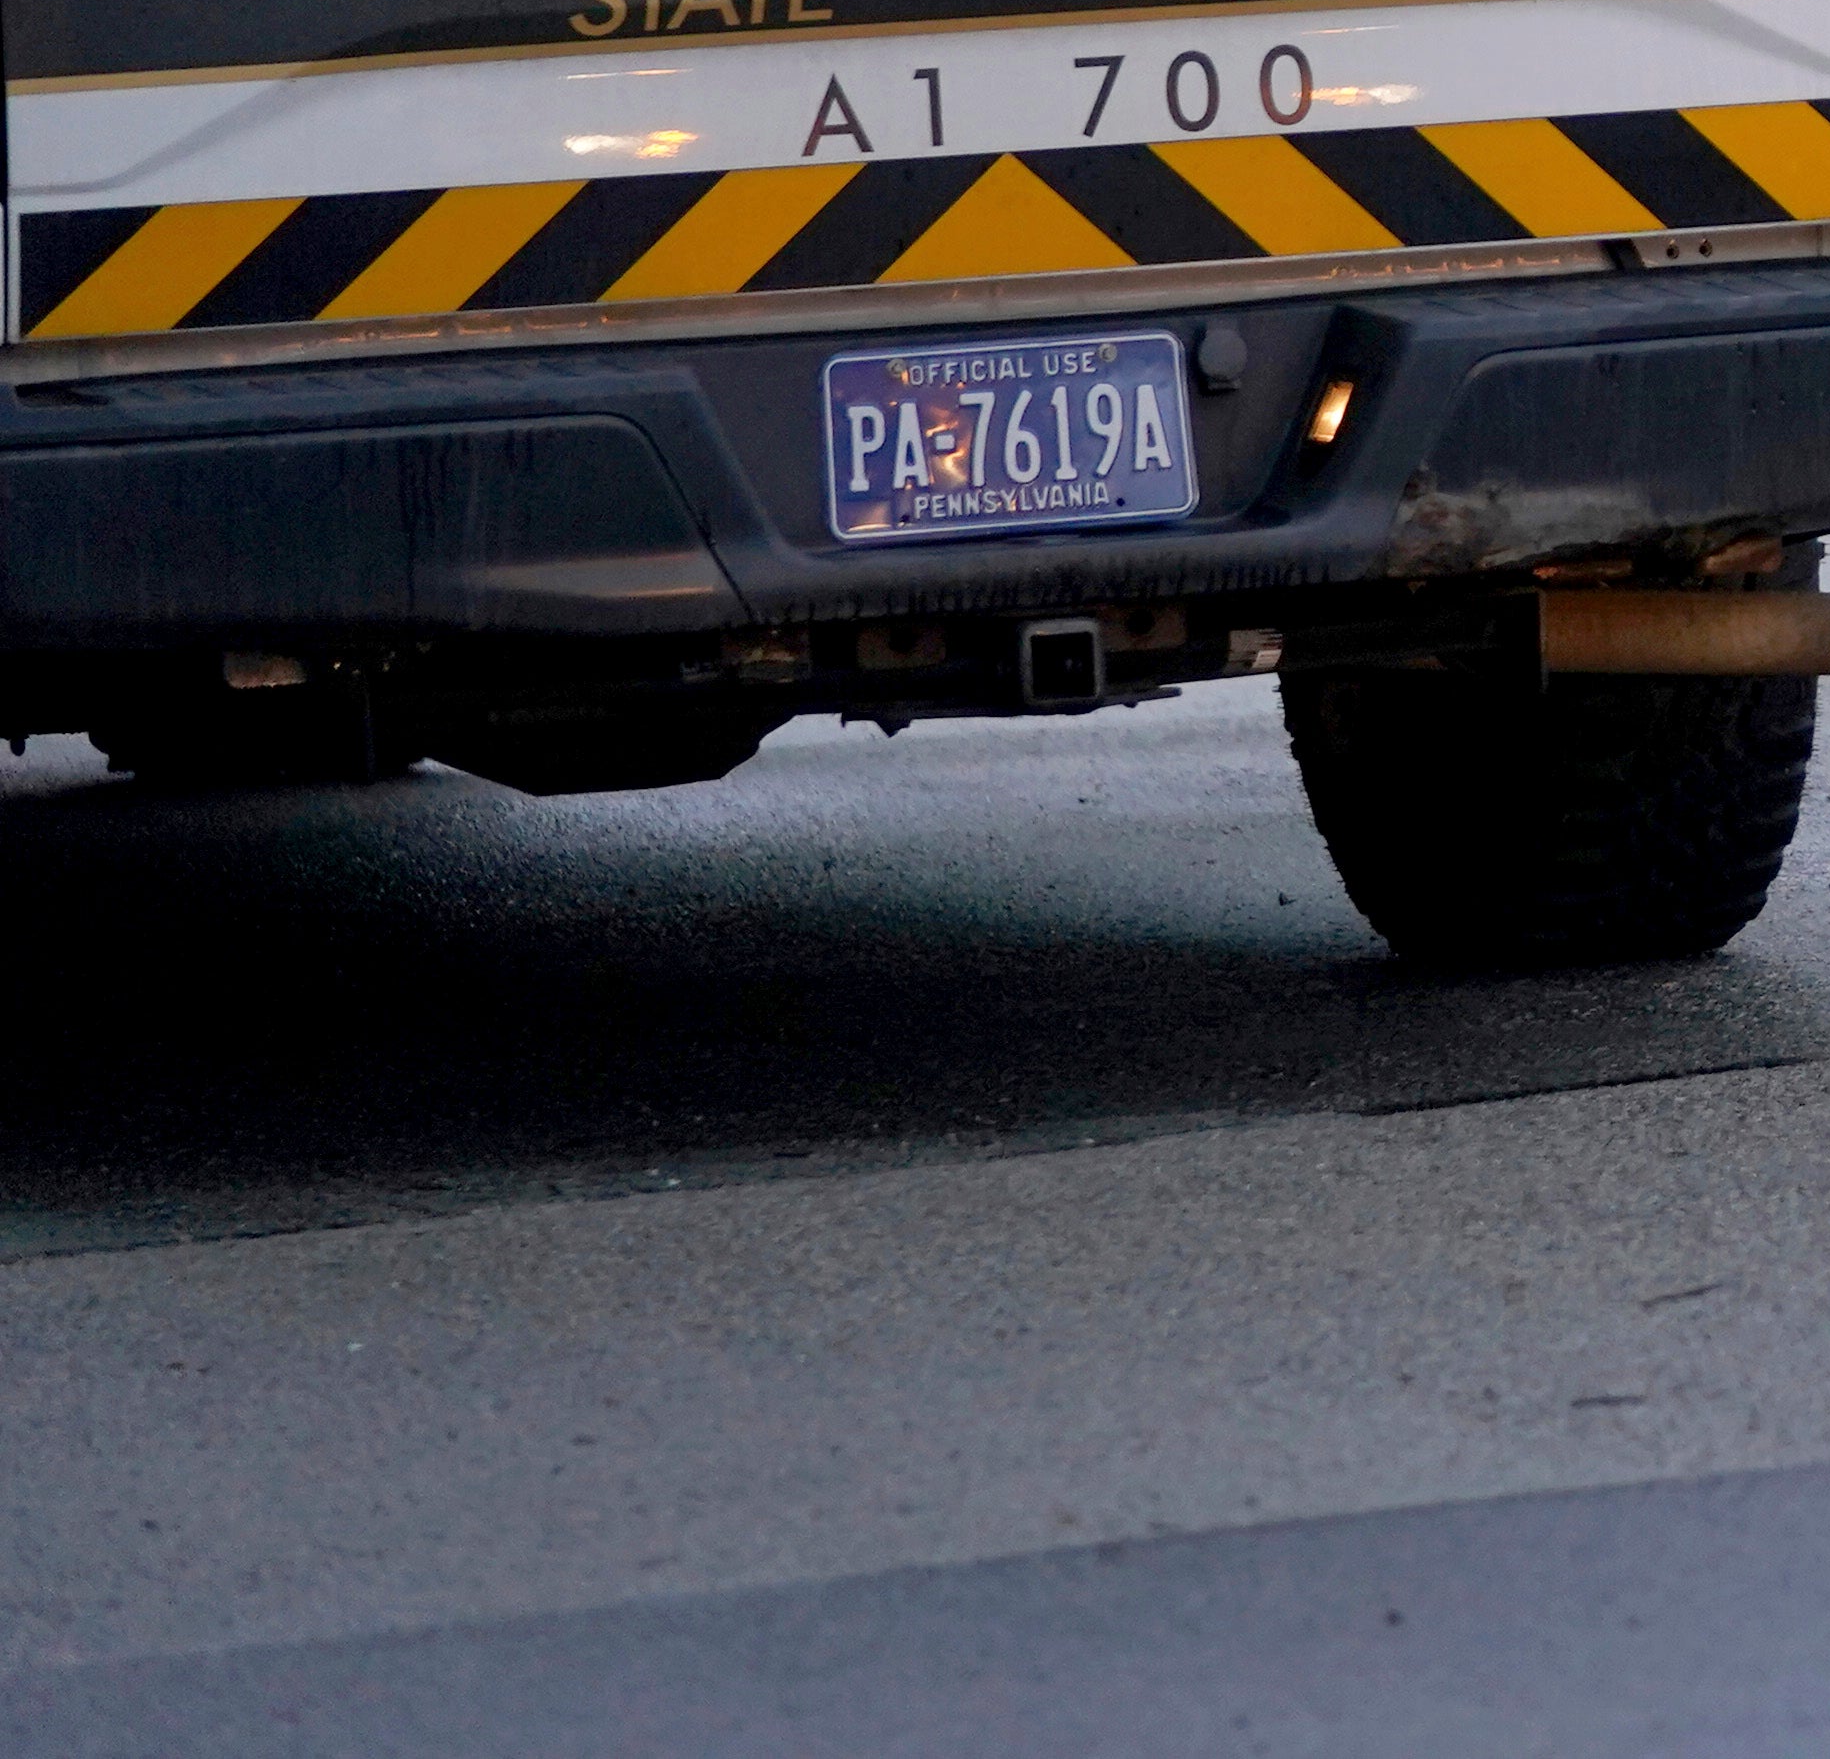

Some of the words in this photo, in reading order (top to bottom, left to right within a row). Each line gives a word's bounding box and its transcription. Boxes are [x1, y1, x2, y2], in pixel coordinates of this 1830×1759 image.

[1073, 43, 1313, 139] 700
[908, 356, 1032, 387] OFFICIAL
[1042, 351, 1097, 376] USE
[846, 382, 1173, 493] PA-7619A
[914, 482, 1110, 520] PENNSYLVANIA
